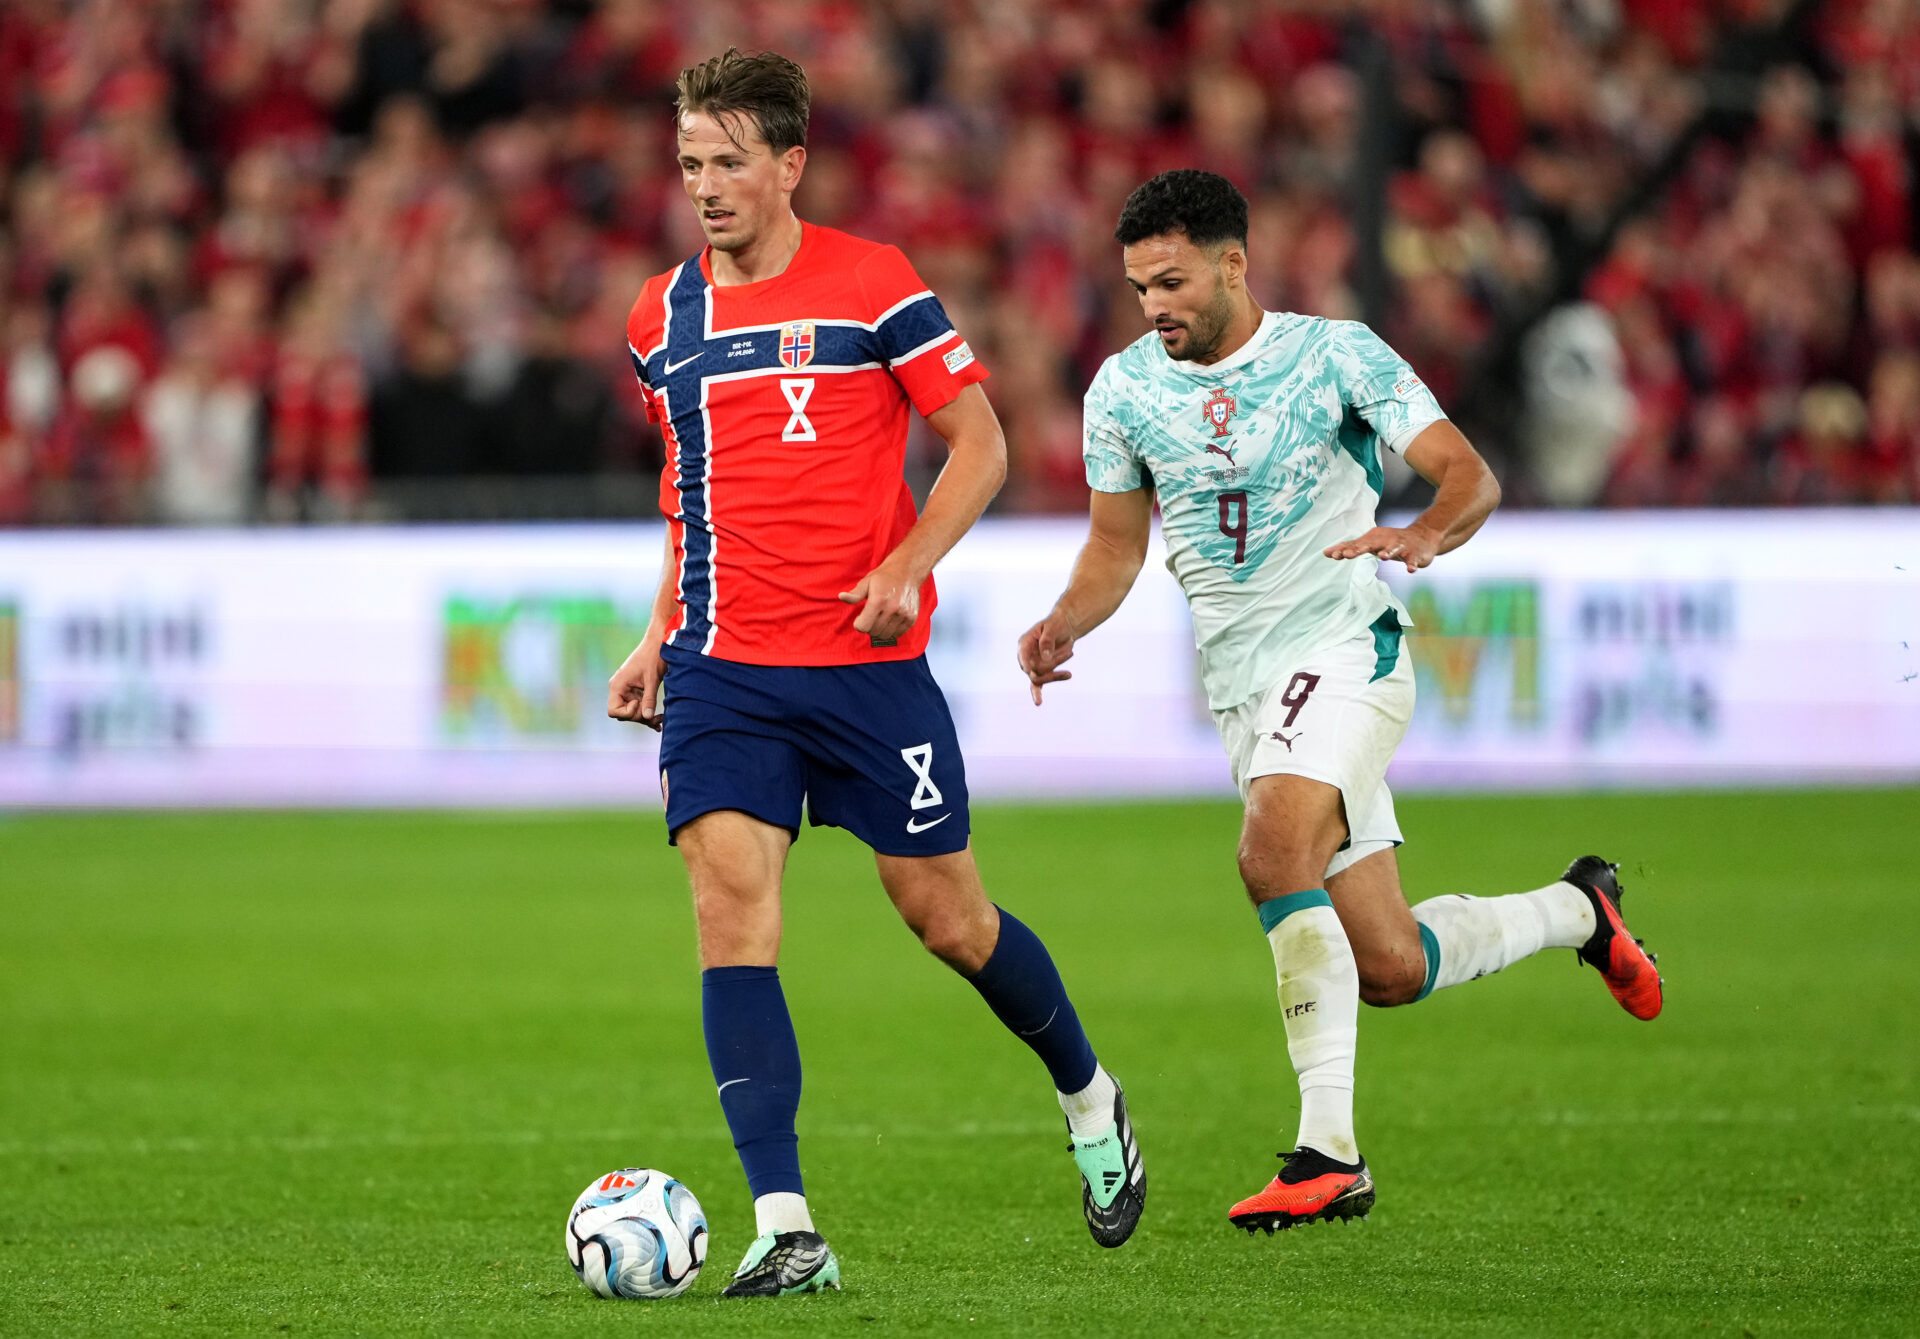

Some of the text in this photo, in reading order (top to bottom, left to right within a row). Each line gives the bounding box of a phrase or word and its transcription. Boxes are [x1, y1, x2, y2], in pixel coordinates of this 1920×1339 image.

[780, 377, 817, 442] 8
[1217, 490, 1248, 563] 9
[1280, 672, 1322, 728] 9
[900, 742, 943, 810] 8
